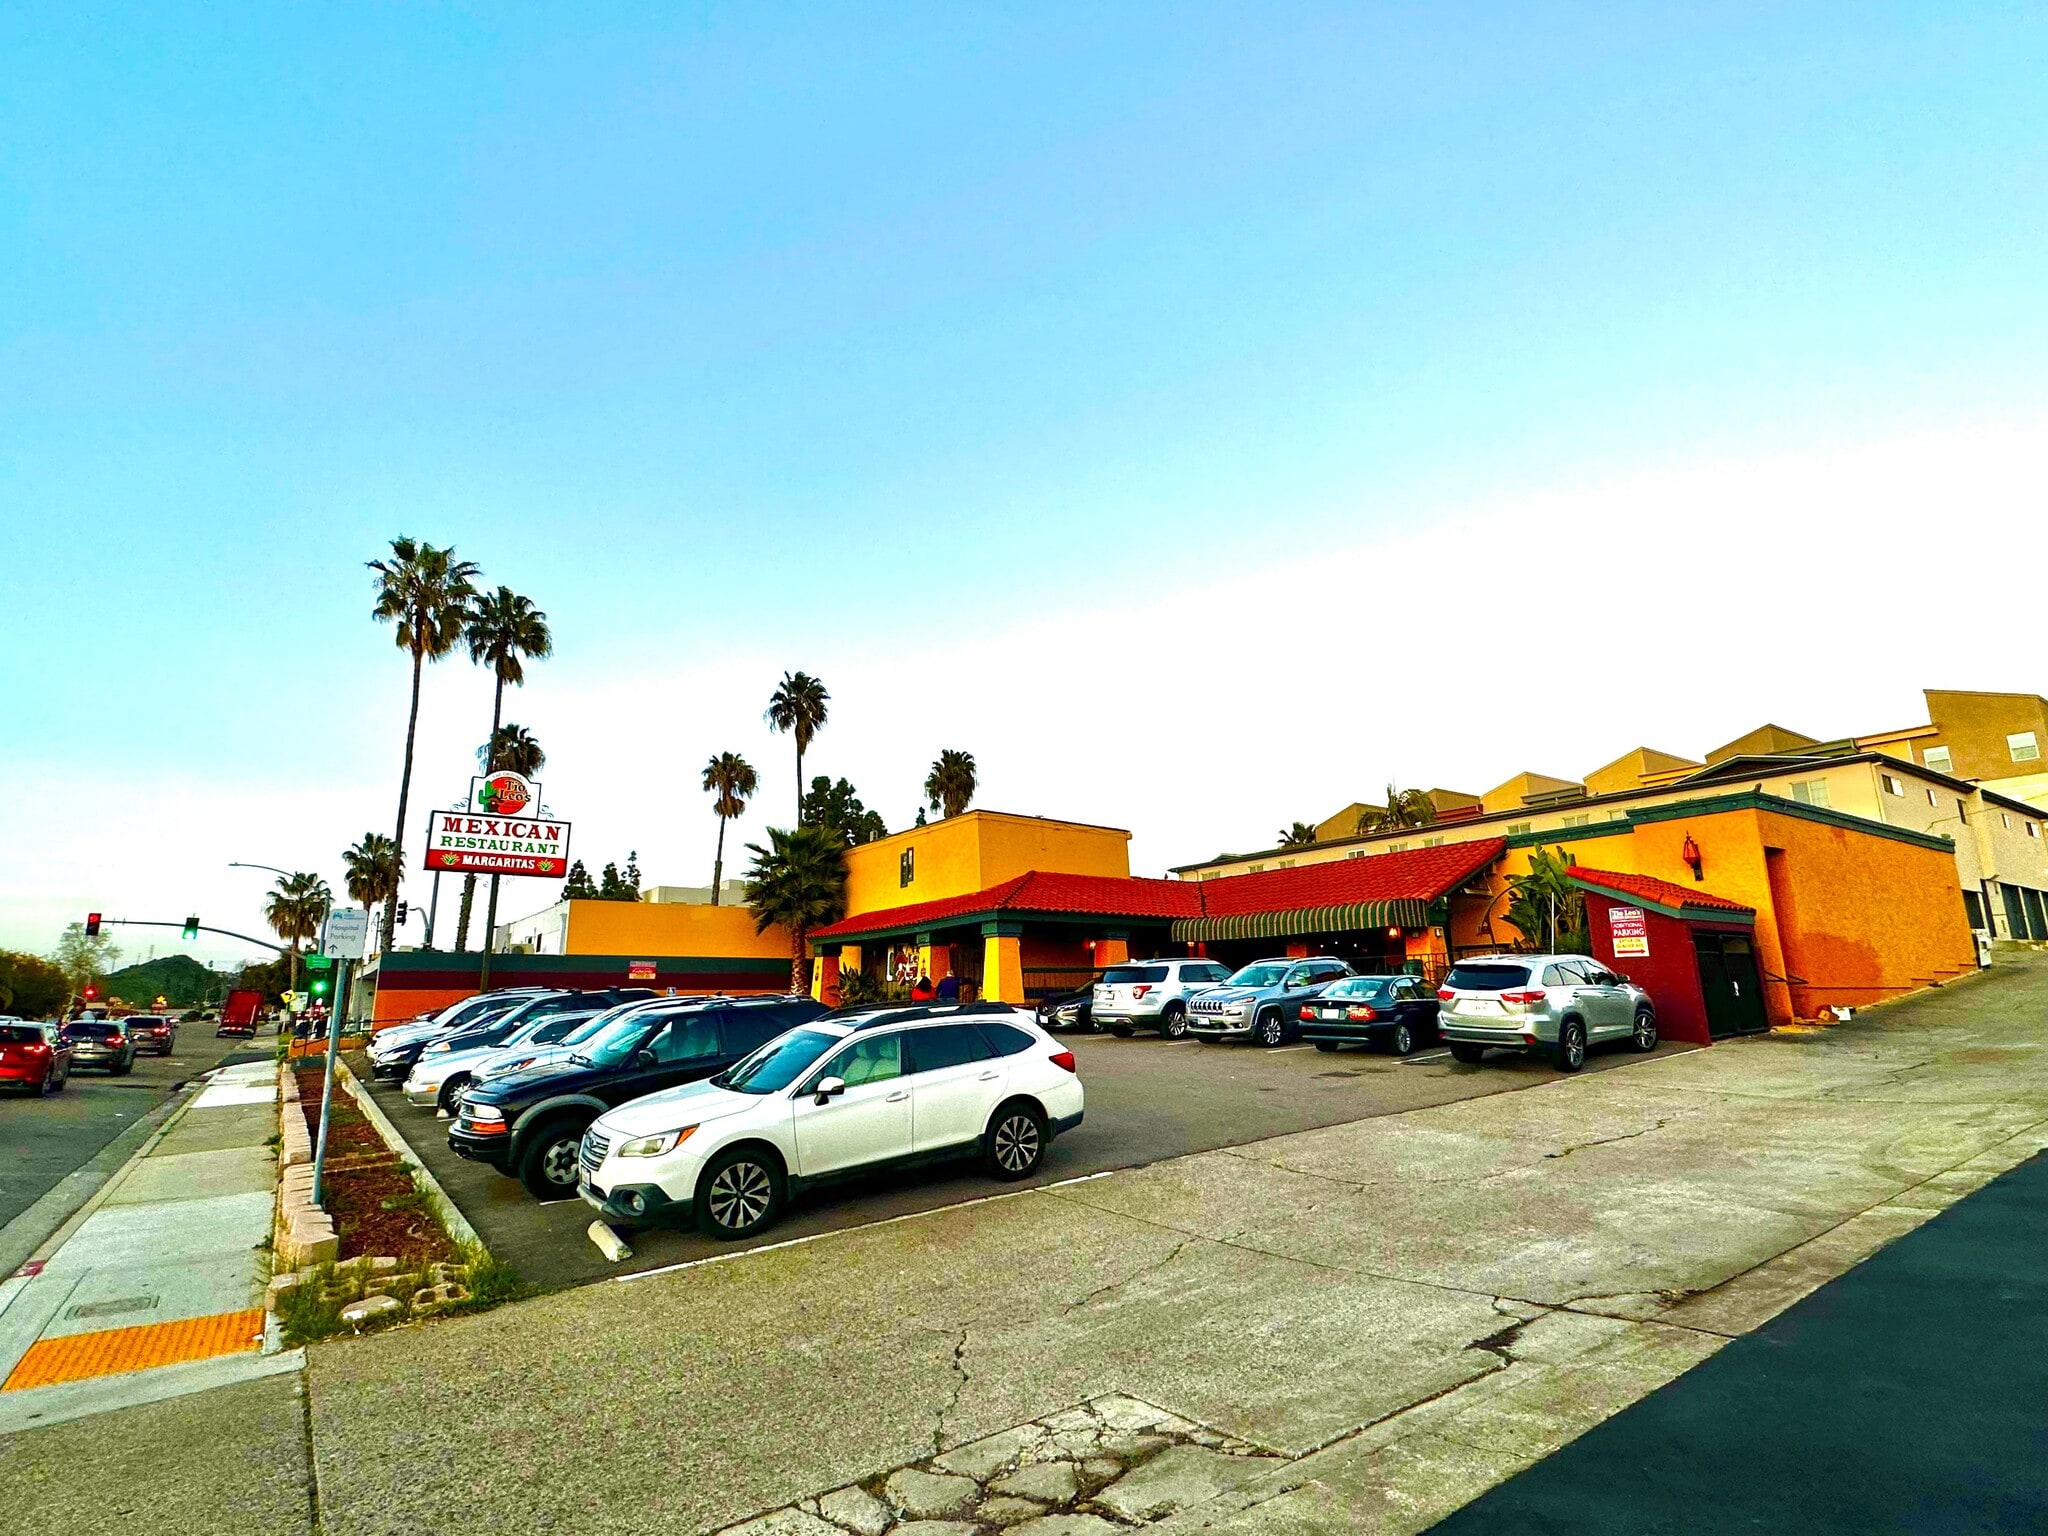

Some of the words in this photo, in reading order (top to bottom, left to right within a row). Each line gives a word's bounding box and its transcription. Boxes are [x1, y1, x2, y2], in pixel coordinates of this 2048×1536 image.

[505, 780, 526, 792] Tio
[442, 816, 561, 841] MEXICAN
[440, 836, 559, 855] RESTAURANT
[462, 855, 535, 869] MARGARITAS
[331, 923, 359, 933] Hospital
[1613, 928, 1645, 937] PARKING
[330, 933, 356, 942] Parking
